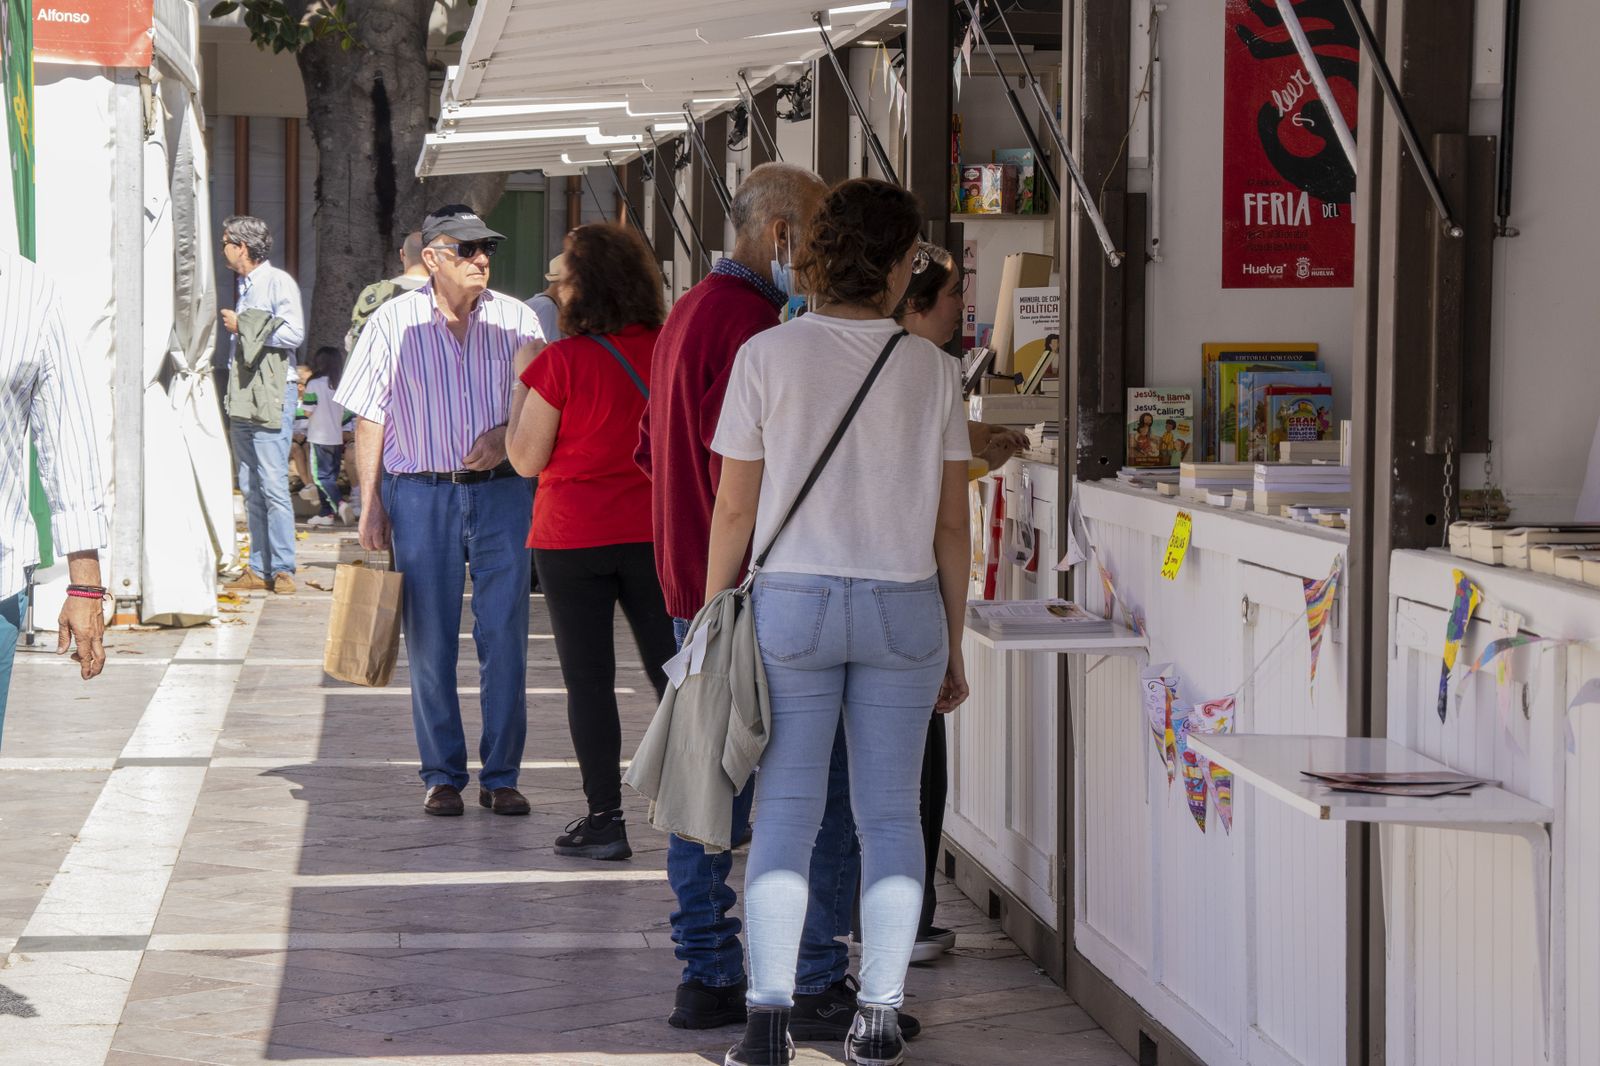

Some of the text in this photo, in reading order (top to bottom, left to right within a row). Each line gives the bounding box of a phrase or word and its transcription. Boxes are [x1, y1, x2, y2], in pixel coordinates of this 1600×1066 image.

[37, 8, 90, 23] Alfonso
[1243, 191, 1311, 226] FERIA
[1322, 202, 1339, 218] DEL
[1242, 263, 1284, 275] Huelva
[1020, 303, 1058, 314] POLÍTICA
[1134, 389, 1190, 402] Jesús te llama
[1288, 416, 1317, 424] GRAN
